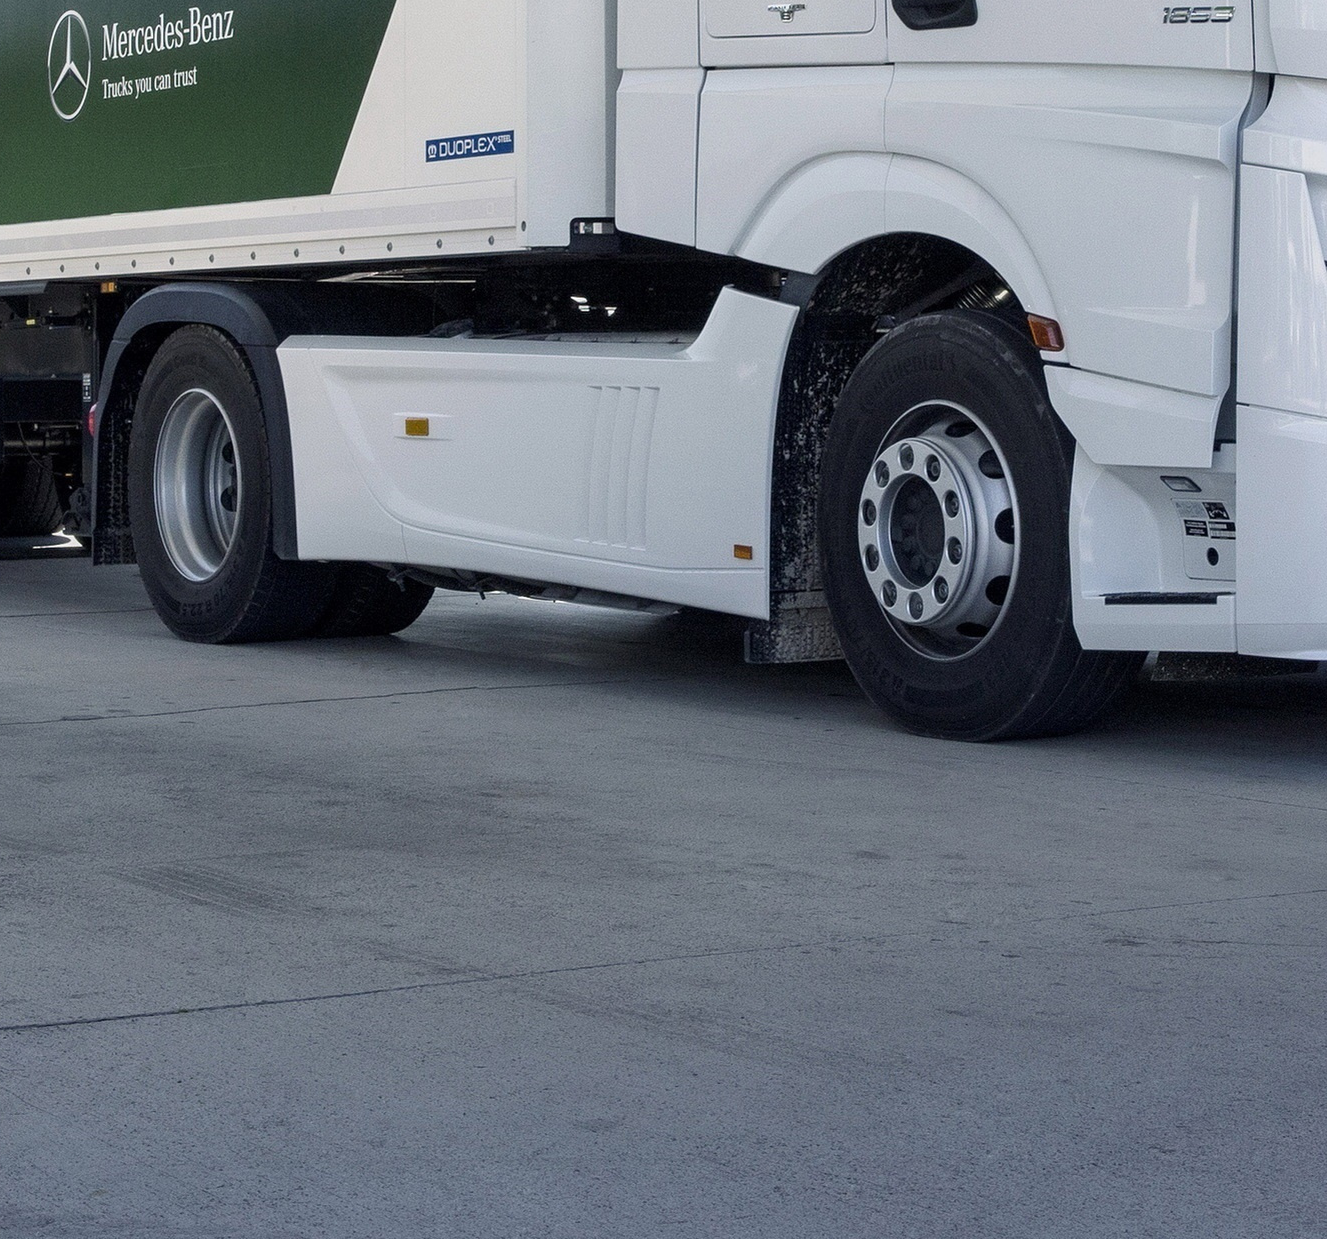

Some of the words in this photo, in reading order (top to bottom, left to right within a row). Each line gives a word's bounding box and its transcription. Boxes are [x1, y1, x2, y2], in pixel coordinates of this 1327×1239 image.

[101, 6, 235, 61] Mercedes-Benz
[101, 76, 134, 100] Trucks
[135, 79, 153, 100] you
[154, 72, 171, 92] can
[173, 65, 198, 88] trust
[439, 136, 496, 158] DUOPLEX
